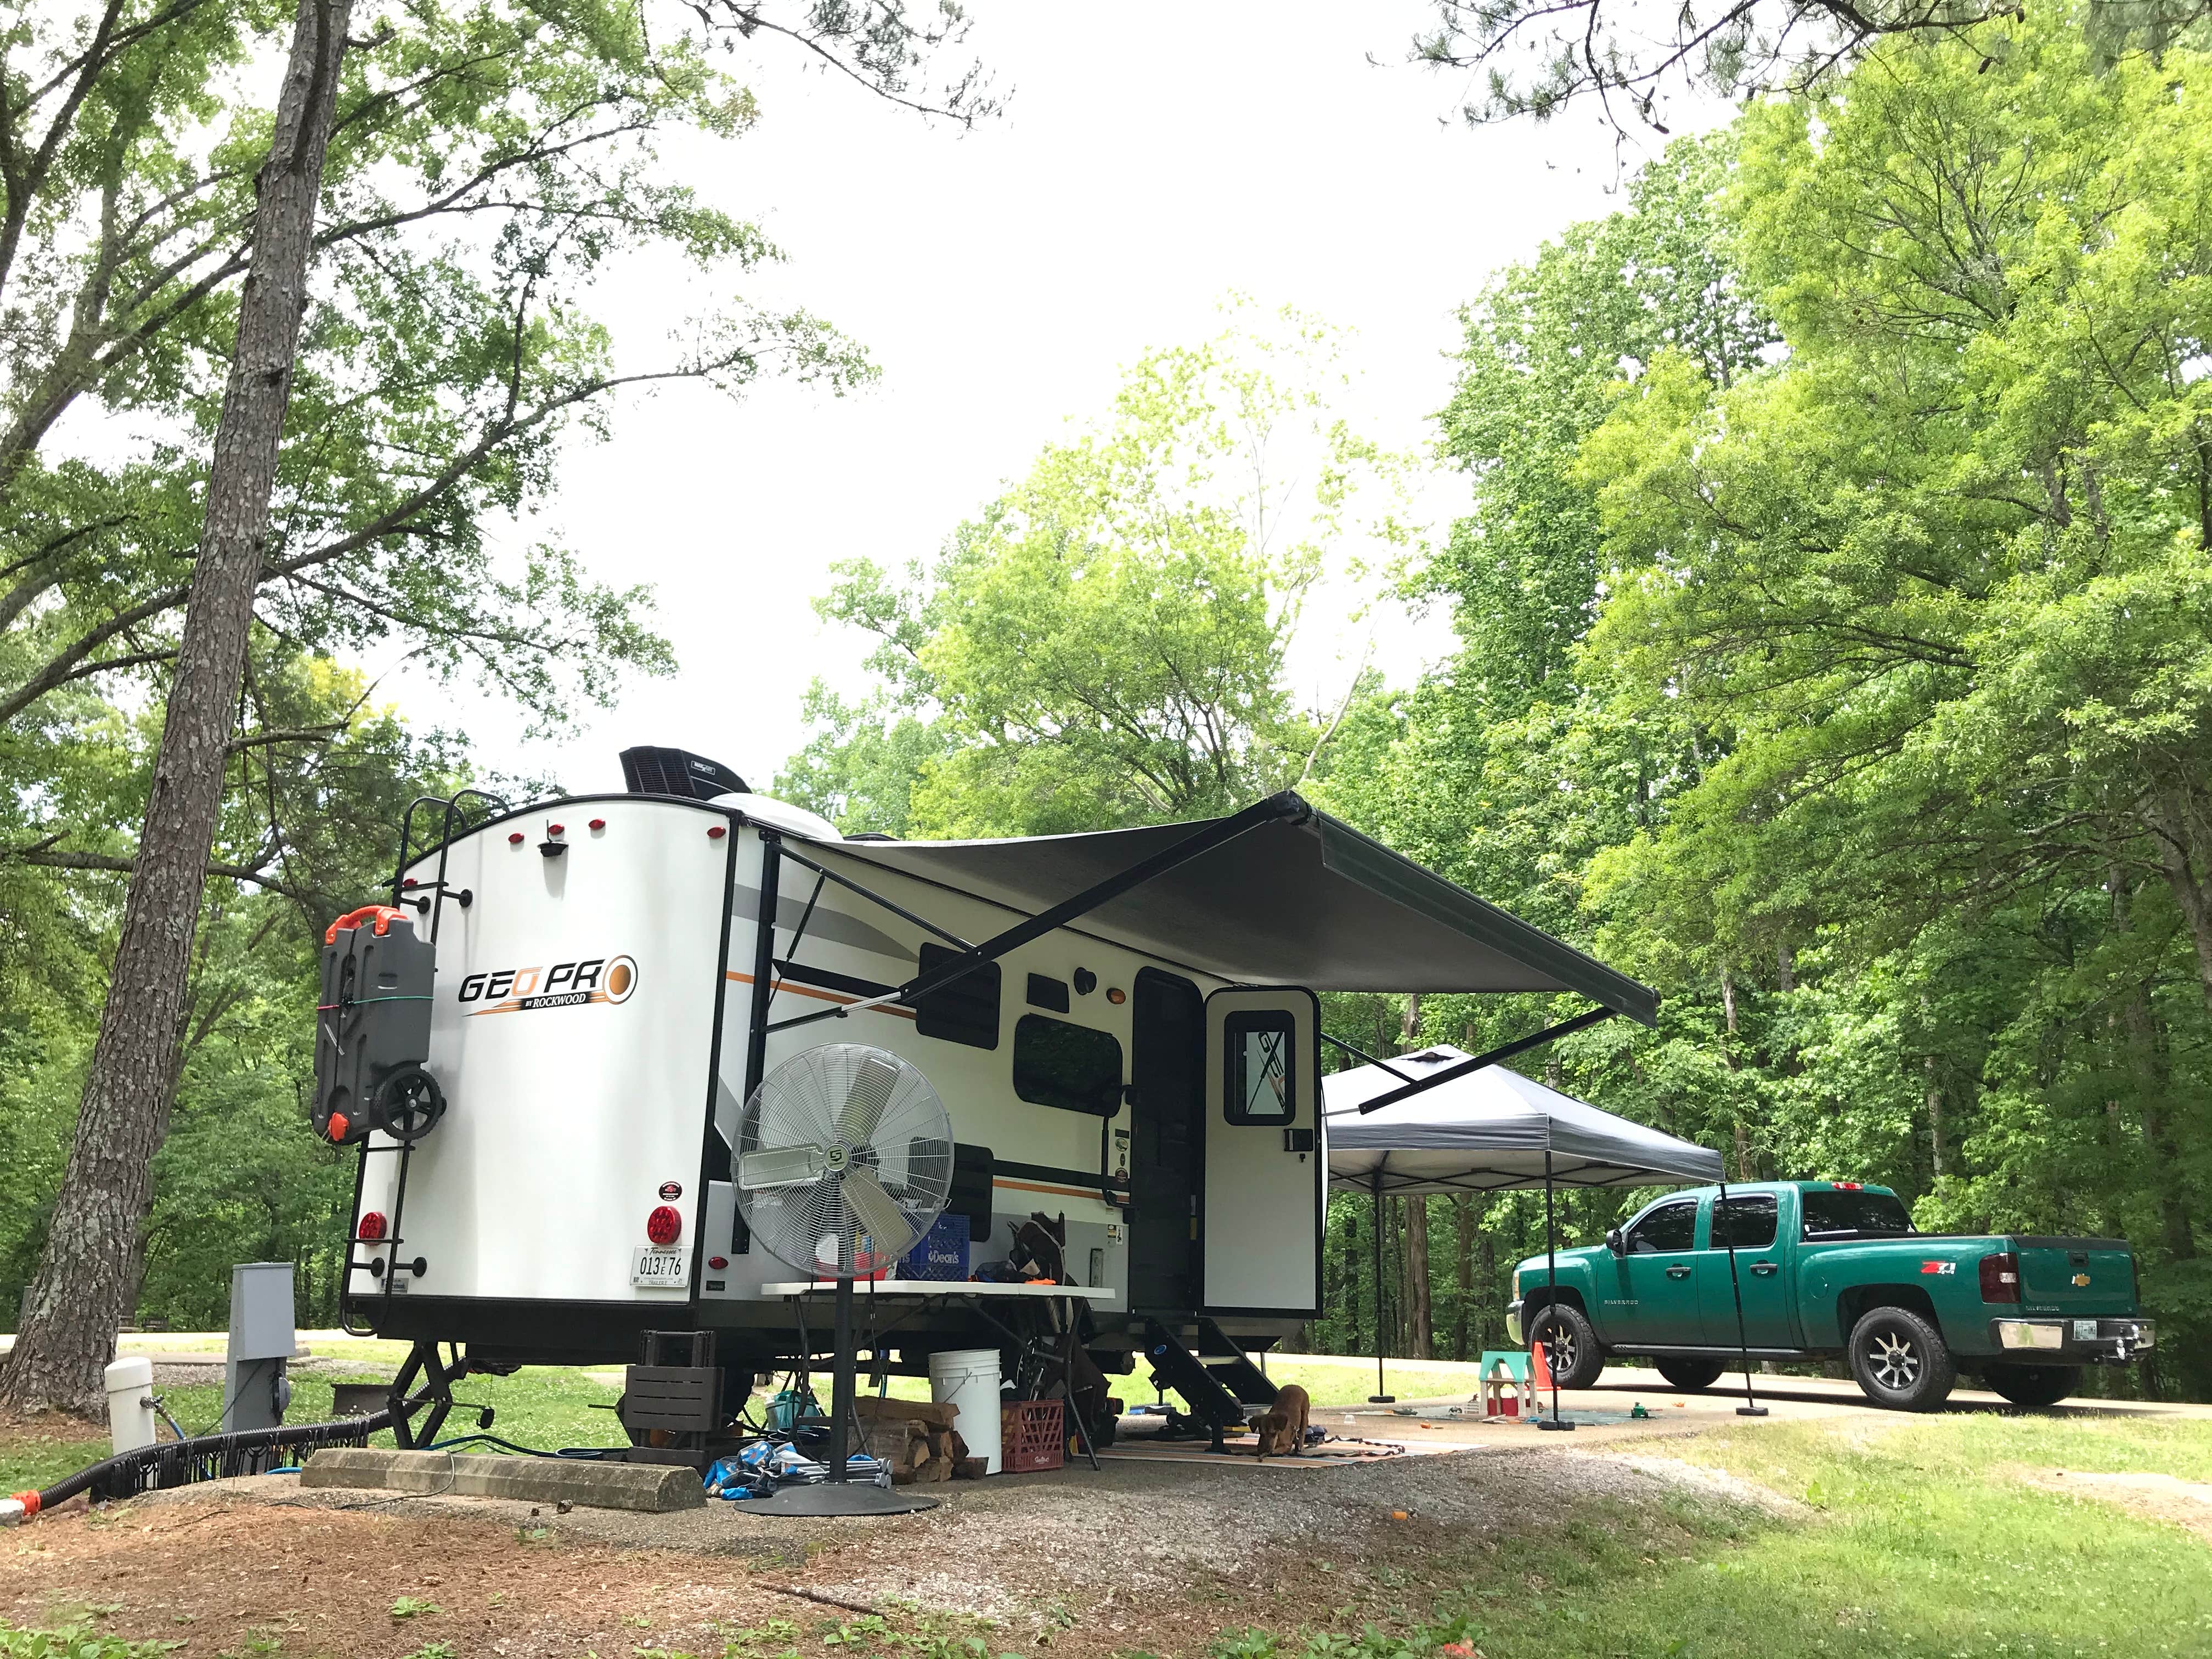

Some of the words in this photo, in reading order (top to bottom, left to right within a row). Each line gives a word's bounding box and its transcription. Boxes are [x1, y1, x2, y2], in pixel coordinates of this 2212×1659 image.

[458, 966, 543, 1002] GEO
[532, 992, 586, 1008] ROCKWOOD
[649, 1247, 677, 1255] Tennessee
[933, 1250, 959, 1264] Dean's
